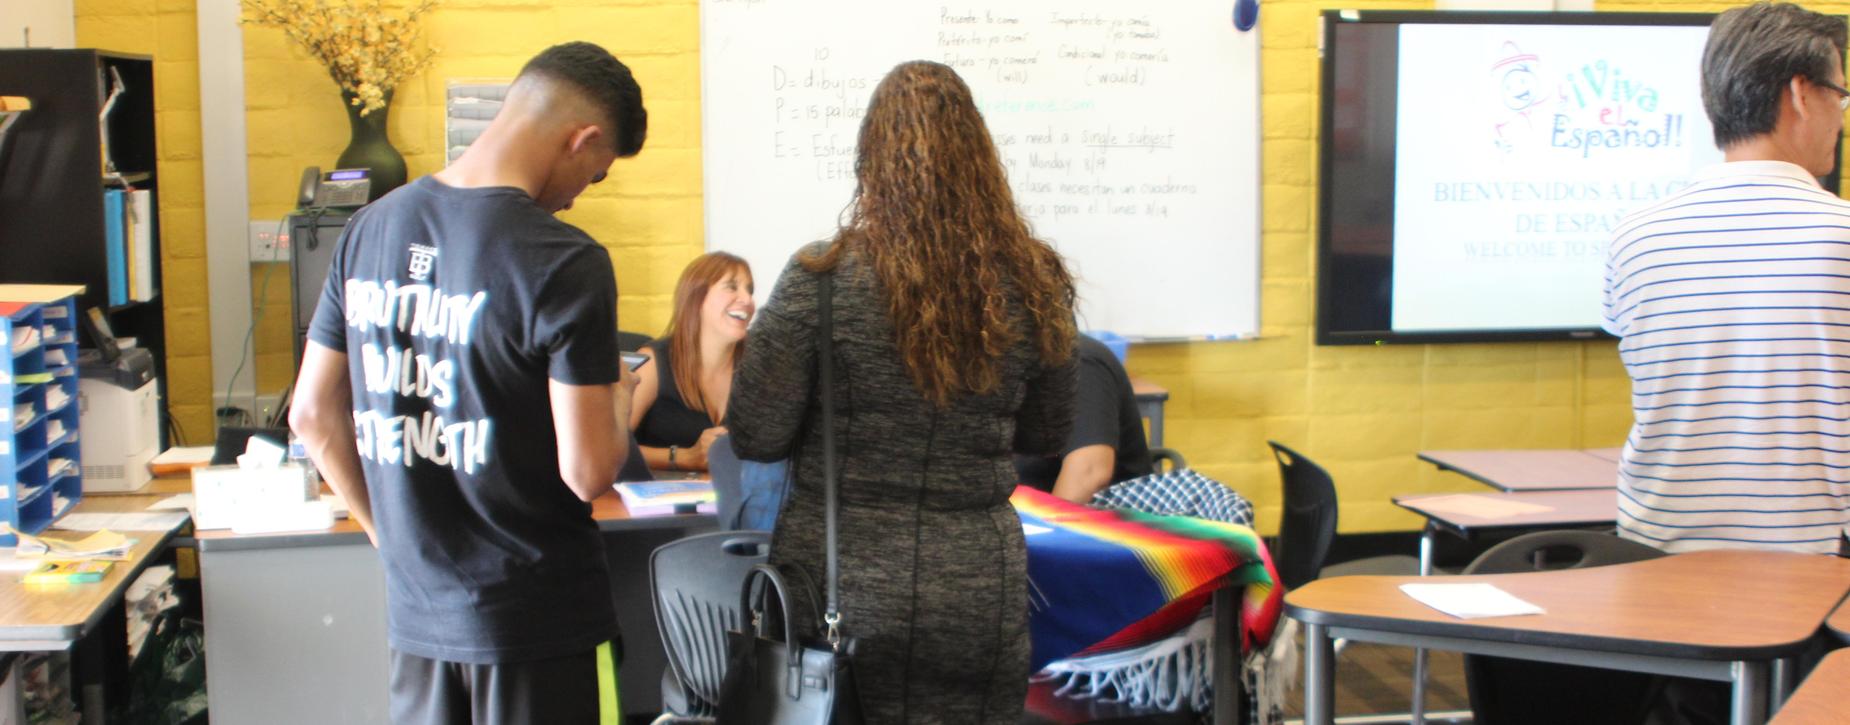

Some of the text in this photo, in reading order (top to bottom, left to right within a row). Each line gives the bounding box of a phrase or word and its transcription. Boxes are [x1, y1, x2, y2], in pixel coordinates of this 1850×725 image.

[803, 67, 867, 100] dibujos
[825, 98, 868, 129] palab
[1025, 124, 1052, 145] need
[1552, 112, 1684, 158] Español!
[1029, 150, 1073, 176] Monday
[1433, 180, 1600, 203] BIENVENIDOS
[1630, 181, 1660, 202] LA
[1053, 203, 1080, 220] para
[1515, 212, 1547, 234] DE
[1463, 240, 1556, 258] WELCOME
[1564, 240, 1588, 257] TO
[346, 278, 487, 345] BRUTALITY
